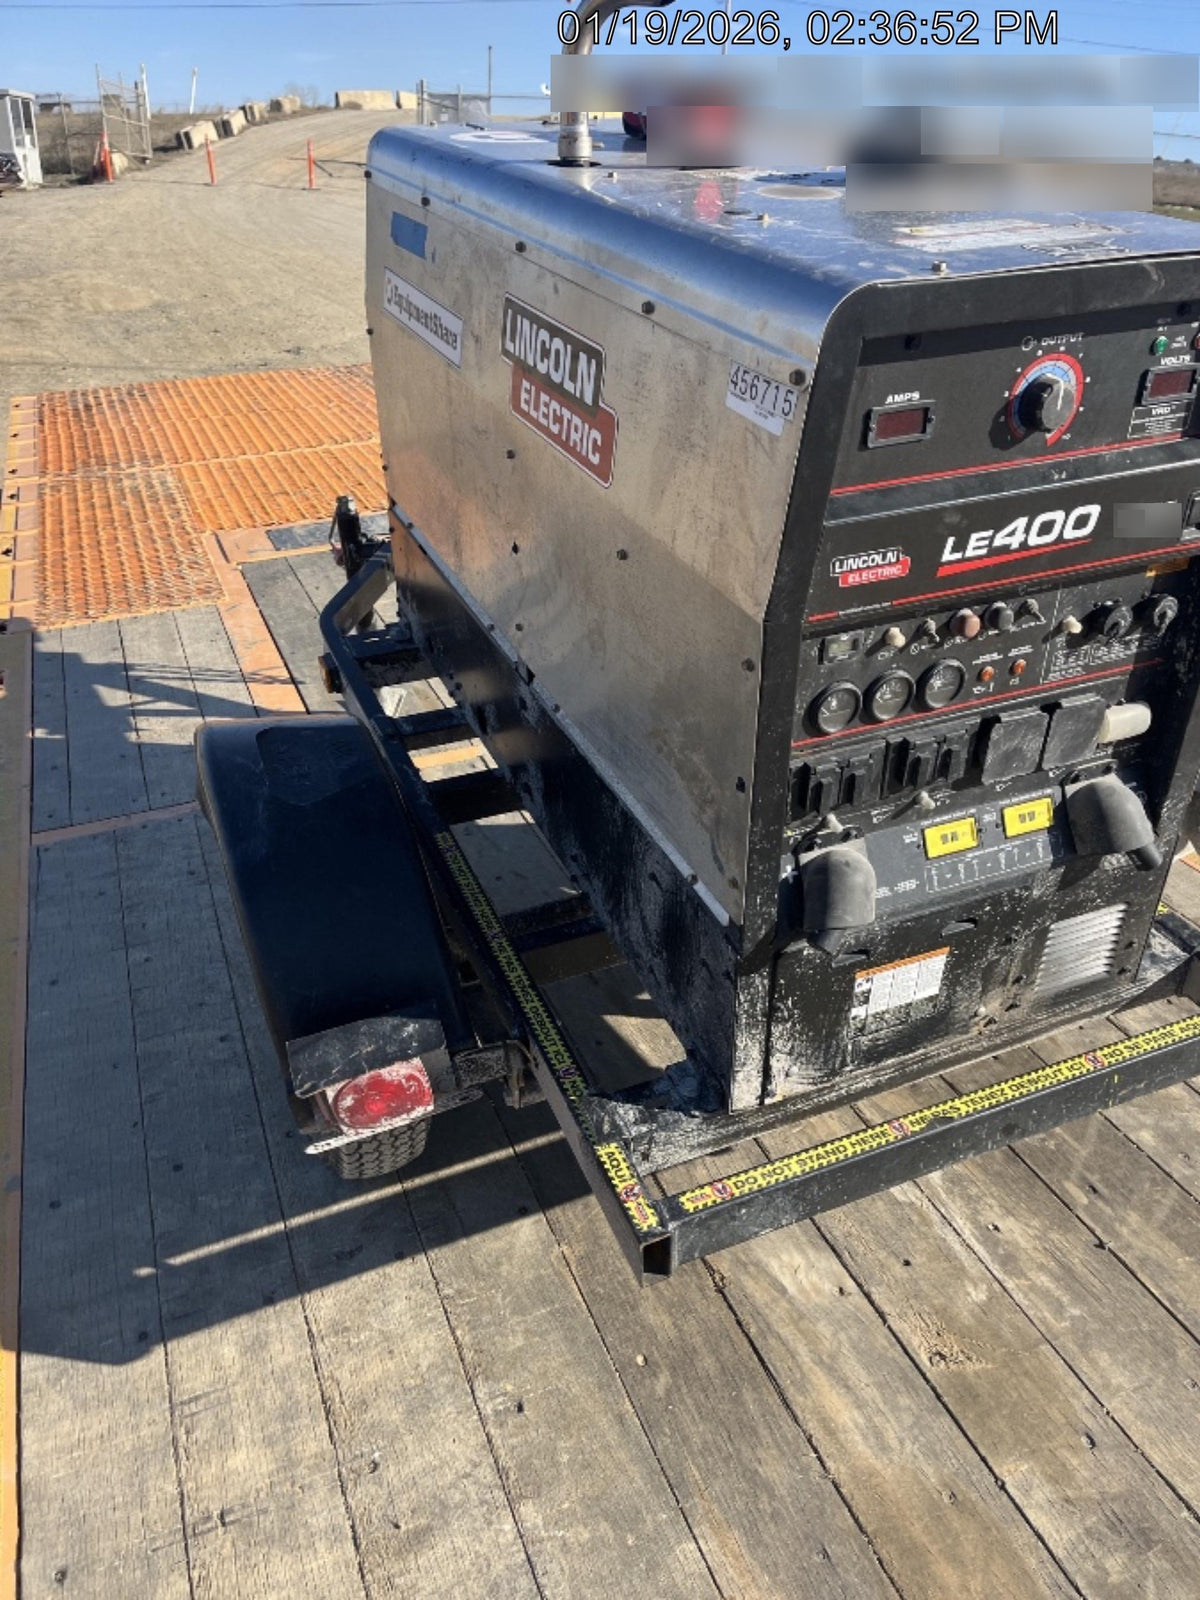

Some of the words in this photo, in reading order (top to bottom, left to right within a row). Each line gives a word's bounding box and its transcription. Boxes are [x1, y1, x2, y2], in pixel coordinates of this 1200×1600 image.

[393, 283, 458, 351] EquipmentShare
[504, 308, 597, 406] LINCOLN
[1160, 354, 1191, 366] VOLTS
[730, 365, 794, 417] 456715
[884, 390, 920, 404] AMPS
[519, 378, 602, 466] ELECTRIC
[940, 503, 1102, 563] LE400
[835, 550, 898, 573] LINCOLN
[847, 565, 903, 584] ELECTRIC
[1102, 1048, 1124, 1061] NO
[962, 1087, 1009, 1109] TENEZ
[1009, 1067, 1065, 1093] DEBOUT
[1066, 1060, 1085, 1075] ICI
[733, 1173, 758, 1190] DO
[764, 1163, 794, 1181] NOT
[797, 1147, 849, 1169] STAND
[849, 1130, 892, 1150] HERE
